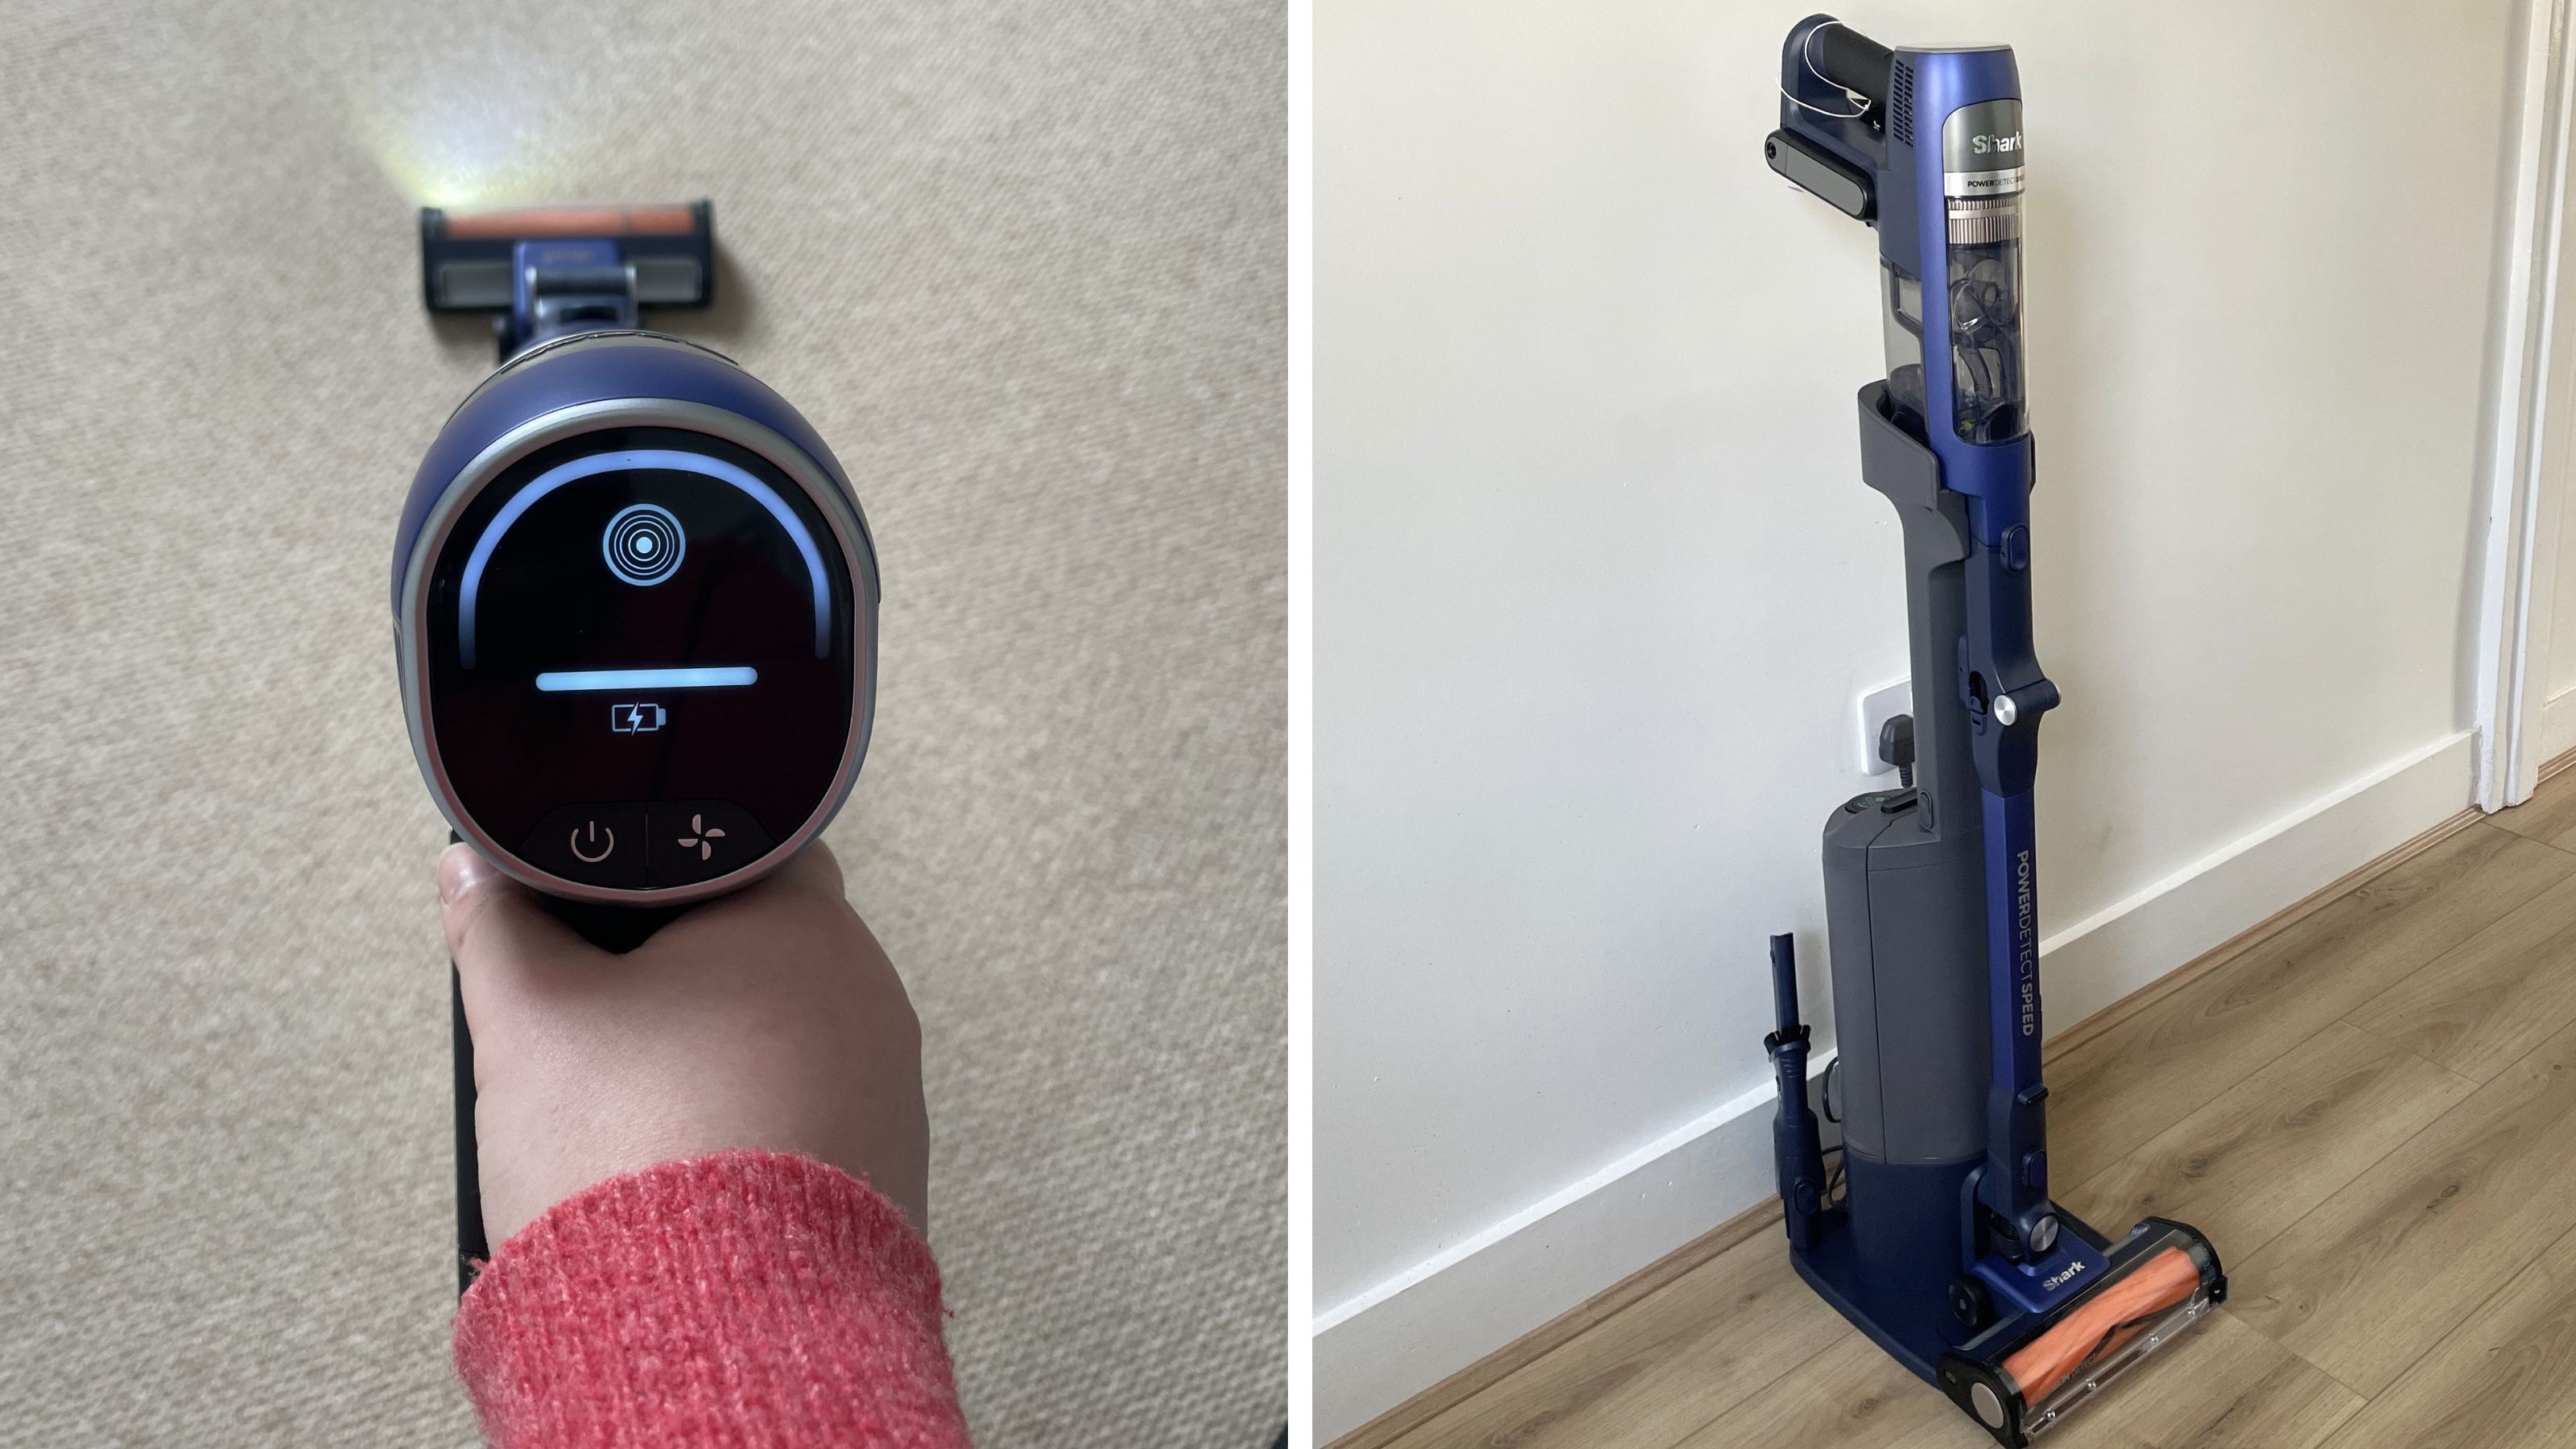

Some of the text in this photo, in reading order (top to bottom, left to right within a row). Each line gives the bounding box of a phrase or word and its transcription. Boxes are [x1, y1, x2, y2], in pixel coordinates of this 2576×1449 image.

[1972, 131, 2022, 154] Shark
[2021, 982, 2034, 1036] SPEED
[2042, 1261, 2086, 1291] Shark
